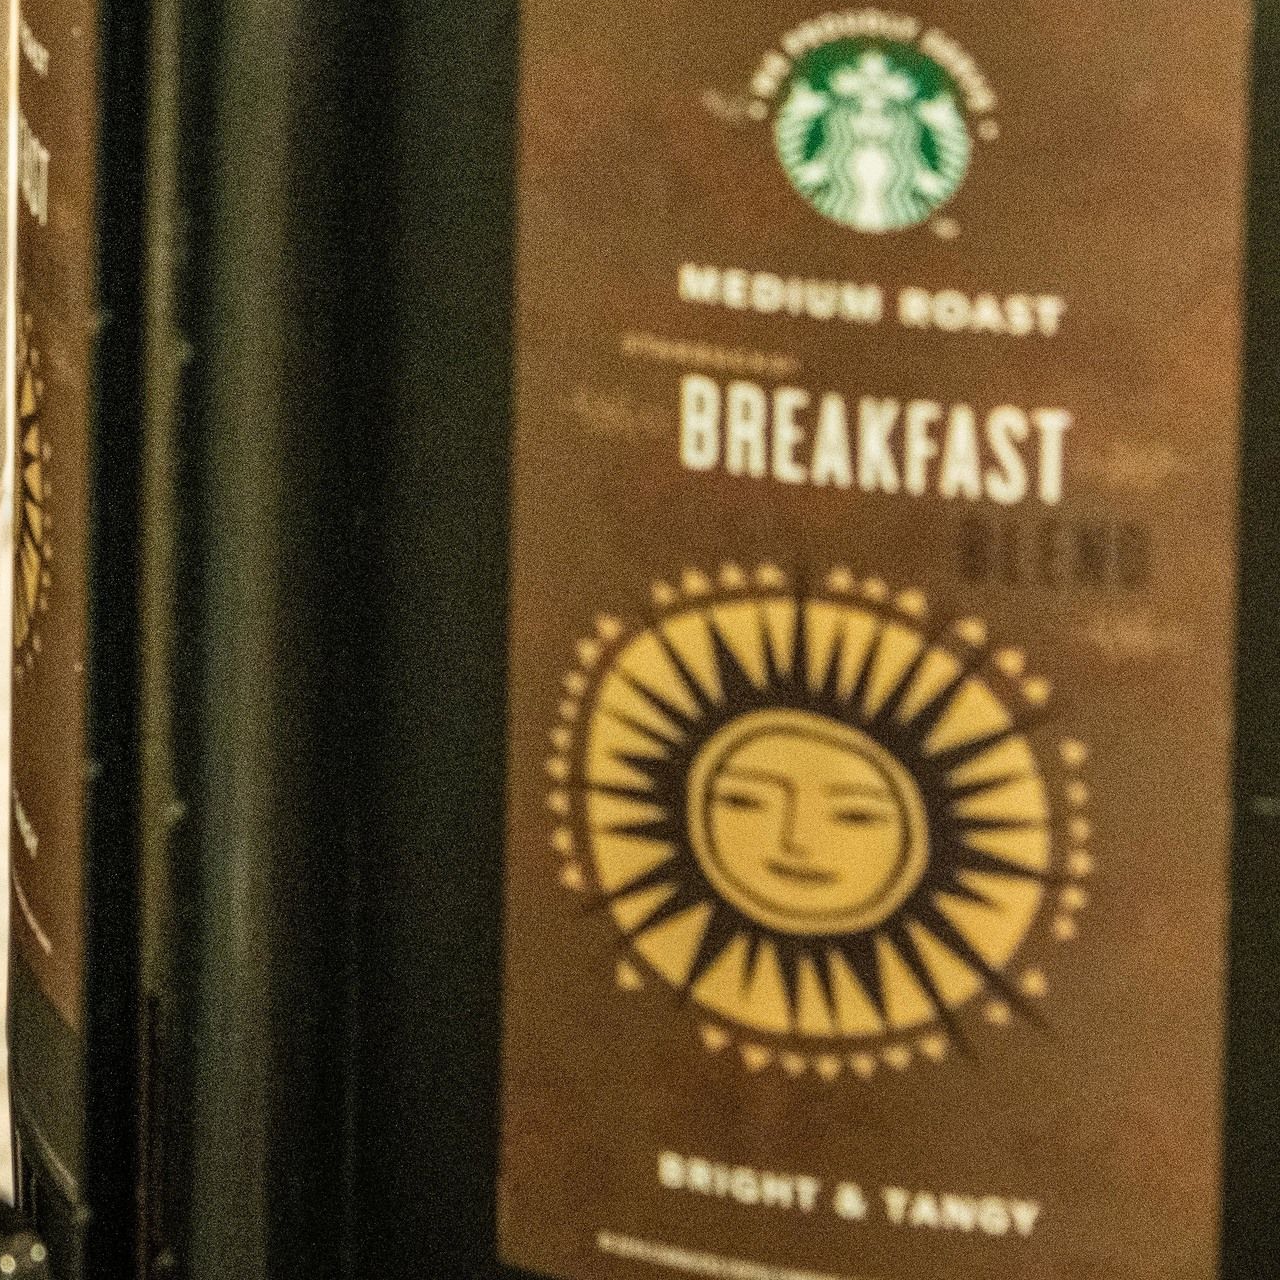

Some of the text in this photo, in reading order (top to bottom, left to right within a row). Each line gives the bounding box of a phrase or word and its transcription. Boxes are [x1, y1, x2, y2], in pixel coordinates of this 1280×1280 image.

[678, 261, 1068, 338] MEDIUM ROAST
[678, 373, 1074, 506] BREAKFAST
[657, 1150, 820, 1214] BRIGHT
[882, 1184, 1040, 1237] TANGY
